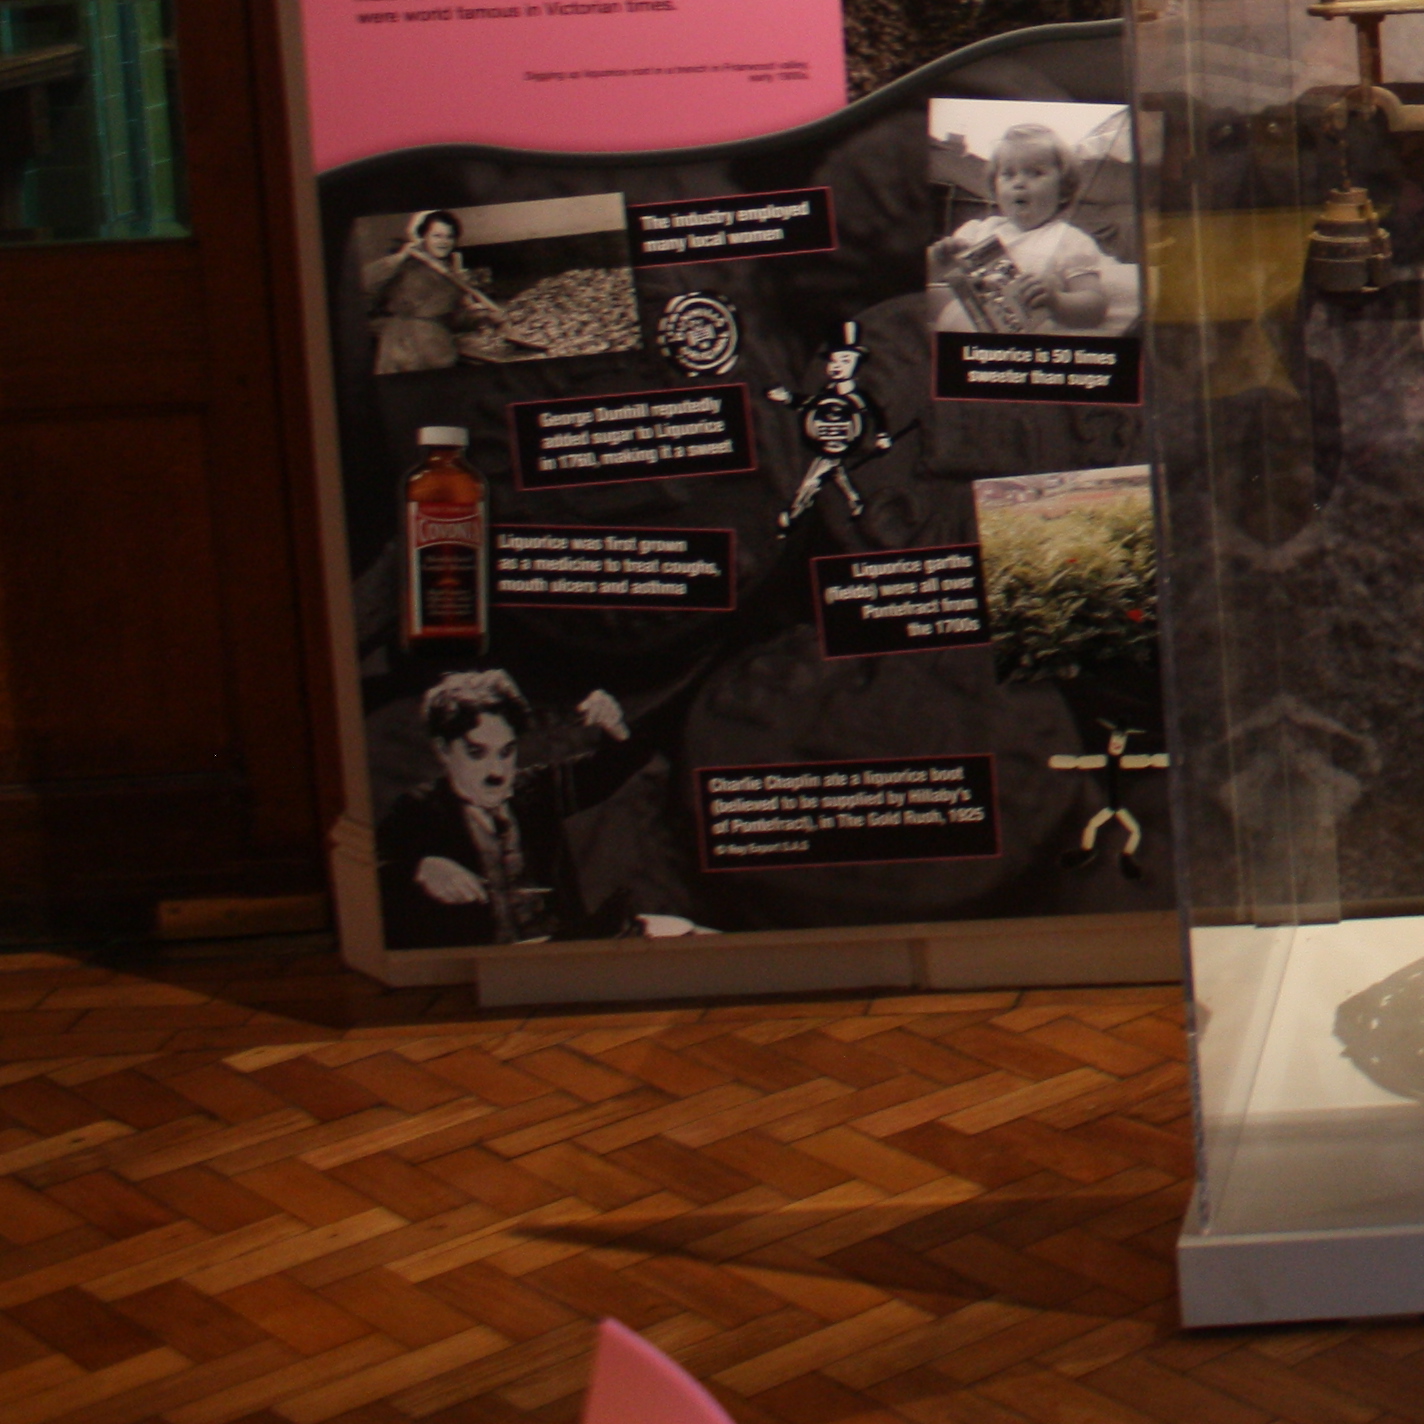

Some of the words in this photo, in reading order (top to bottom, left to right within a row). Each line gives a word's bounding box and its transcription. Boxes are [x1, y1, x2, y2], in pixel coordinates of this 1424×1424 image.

[962, 346, 1032, 363] Liquorice
[1035, 348, 1049, 363] is
[1051, 348, 1072, 363] 50
[1073, 349, 1116, 364] times
